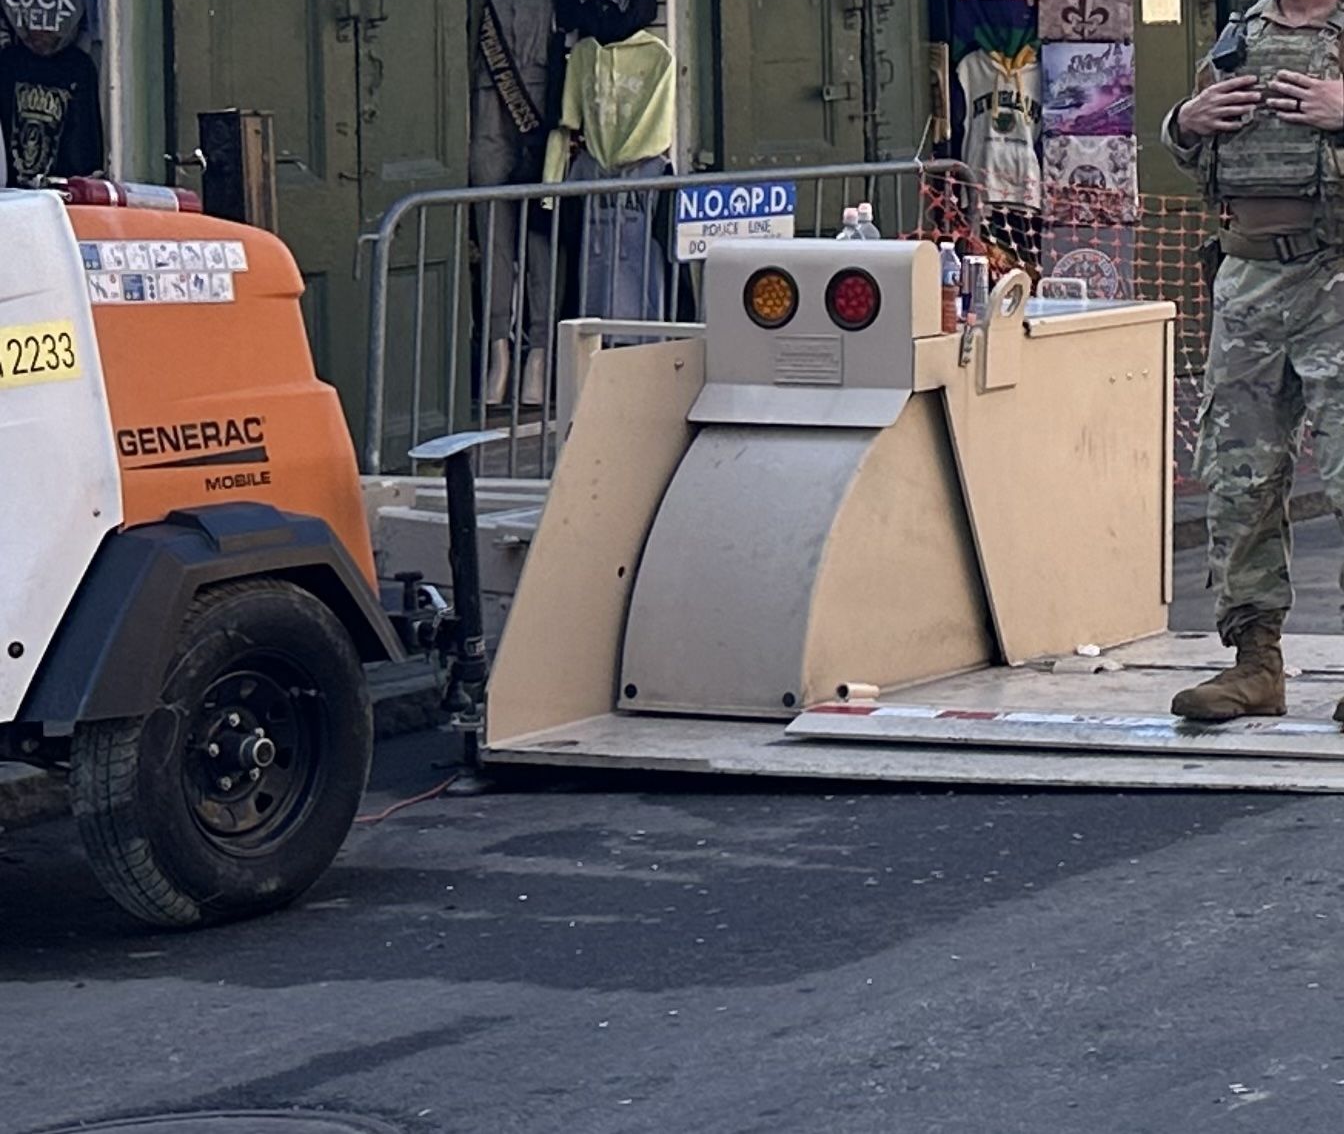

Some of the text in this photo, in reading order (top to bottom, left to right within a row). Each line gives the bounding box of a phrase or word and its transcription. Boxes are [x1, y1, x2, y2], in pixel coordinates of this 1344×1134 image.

[689, 241, 707, 254] DO
[117, 417, 265, 456] GENERAC
[205, 471, 272, 491] MOBILE
